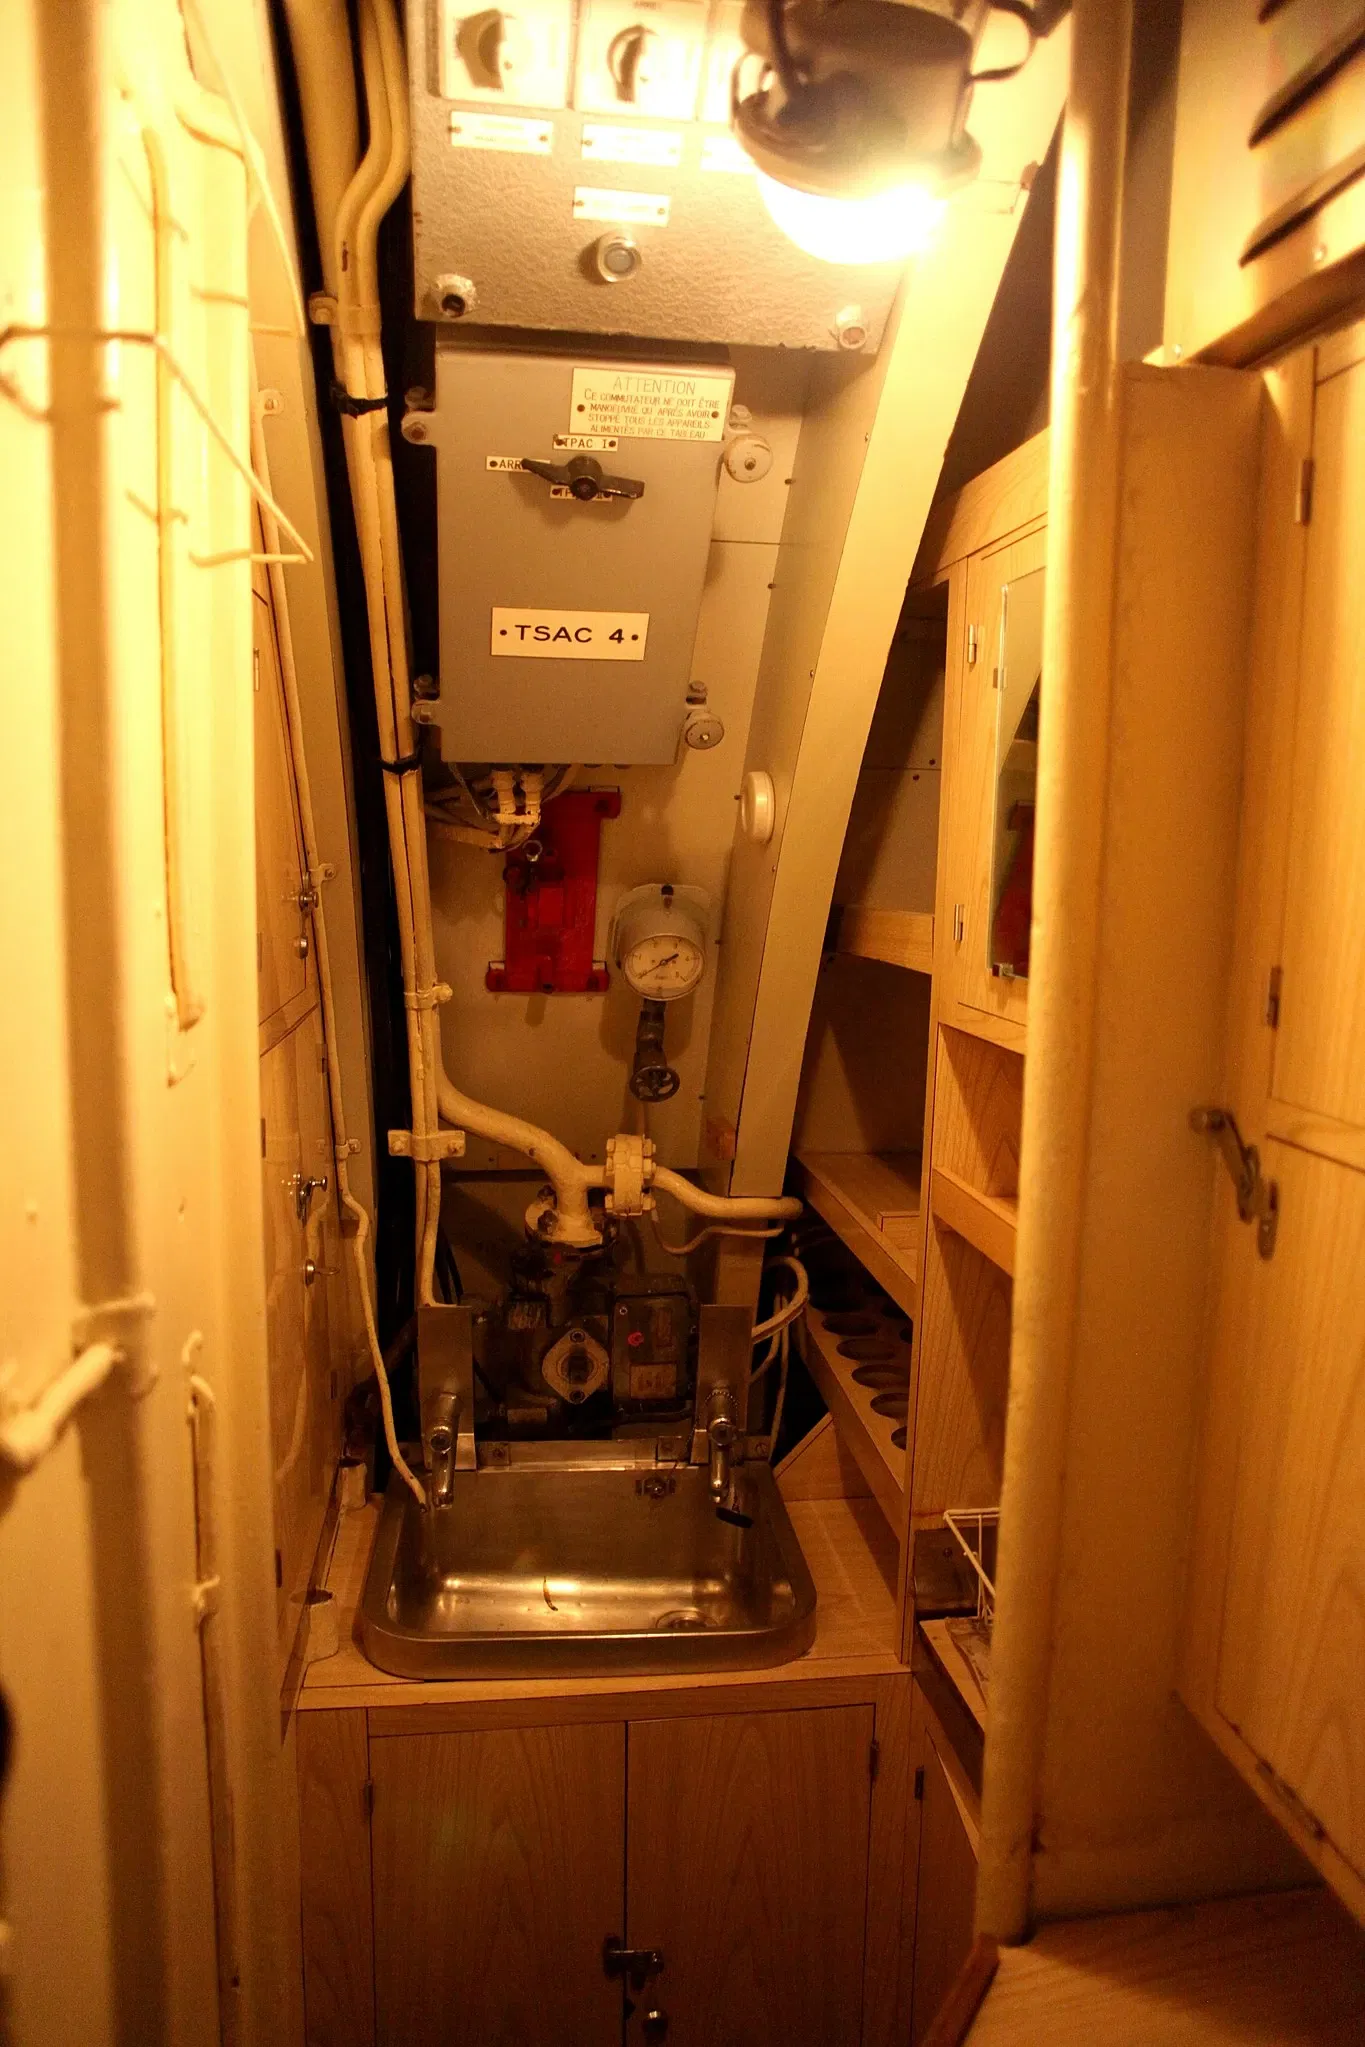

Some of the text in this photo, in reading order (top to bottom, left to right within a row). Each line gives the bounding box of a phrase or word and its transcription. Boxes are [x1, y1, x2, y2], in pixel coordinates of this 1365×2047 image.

[613, 376, 696, 395] ATTENTION
[600, 394, 661, 406] COMMUTATEUR
[663, 397, 674, 406] NE
[677, 398, 695, 408] DOIT
[698, 396, 720, 409] ÊTRE
[686, 408, 710, 418] AVOIR
[625, 415, 646, 425] TOUS
[648, 417, 664, 426] LES
[667, 418, 710, 429] APPAREILS
[637, 427, 653, 436] PAR
[656, 429, 665, 437] CE
[670, 429, 706, 439] TABLEAU
[563, 437, 593, 449] TPAC
[499, 459, 521, 470] ARR
[514, 624, 625, 644] TSAC 4
